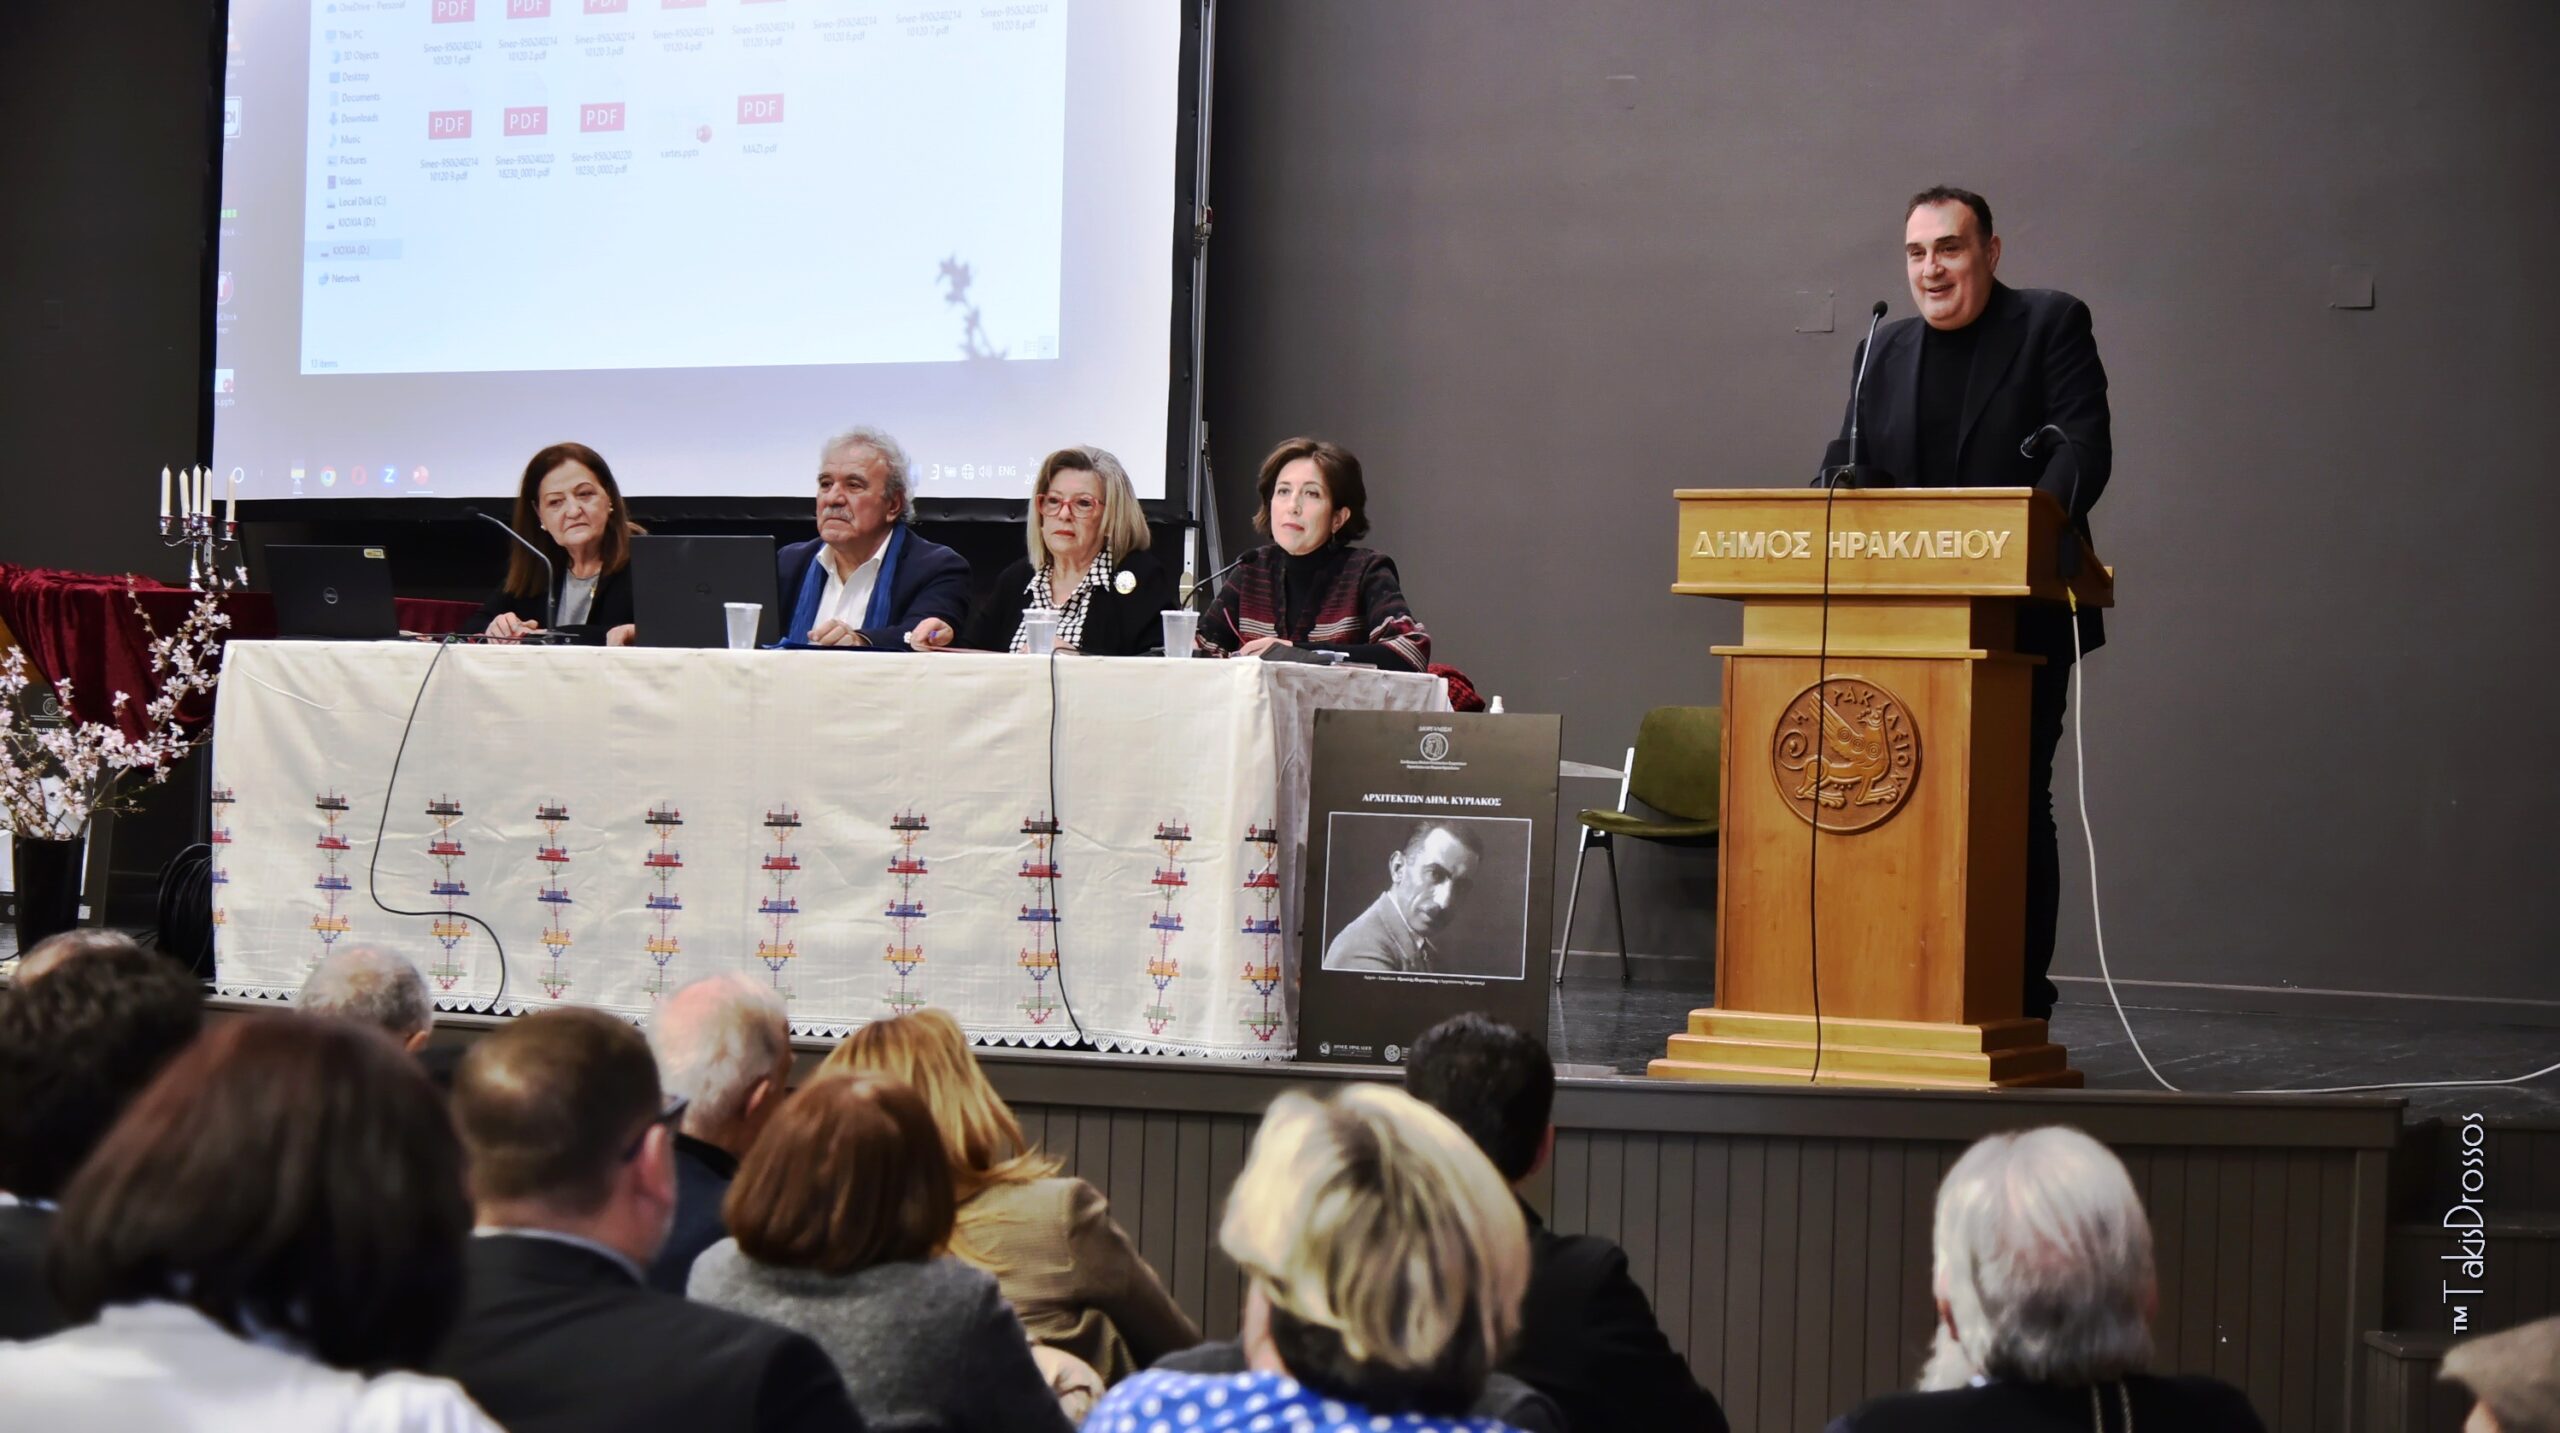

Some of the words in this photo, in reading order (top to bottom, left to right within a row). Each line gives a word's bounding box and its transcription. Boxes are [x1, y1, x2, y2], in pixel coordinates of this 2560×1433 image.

[438, 2, 468, 17] PDF
[339, 30, 352, 40] This
[353, 30, 364, 39] PC
[344, 51, 352, 61] 3D
[353, 50, 380, 63] Objects
[342, 72, 370, 83] Desktop
[342, 93, 380, 103] Documents
[743, 100, 777, 118] PDF
[341, 113, 379, 124] Downloads
[509, 113, 540, 130] PDF
[585, 109, 617, 126] PDF
[434, 116, 465, 133] PDF
[341, 135, 361, 145] Music
[340, 155, 367, 165] Pictures
[339, 176, 362, 186] Videos
[339, 197, 357, 207] Local
[358, 196, 372, 207] Disk
[331, 273, 360, 283] Network
[998, 465, 1016, 477] ENG
[1690, 529, 1812, 559] ΔΗΜΟΣ
[1829, 529, 2011, 559] ΗΡΑΚΛΕΙΟΥ
[1362, 793, 1424, 804] ΑΡΧΙΤΕΚΤΩΝ
[1425, 795, 1449, 805] ΔΗΜ.
[1451, 796, 1502, 807] ΚΥΡΙΑΚΟΣ
